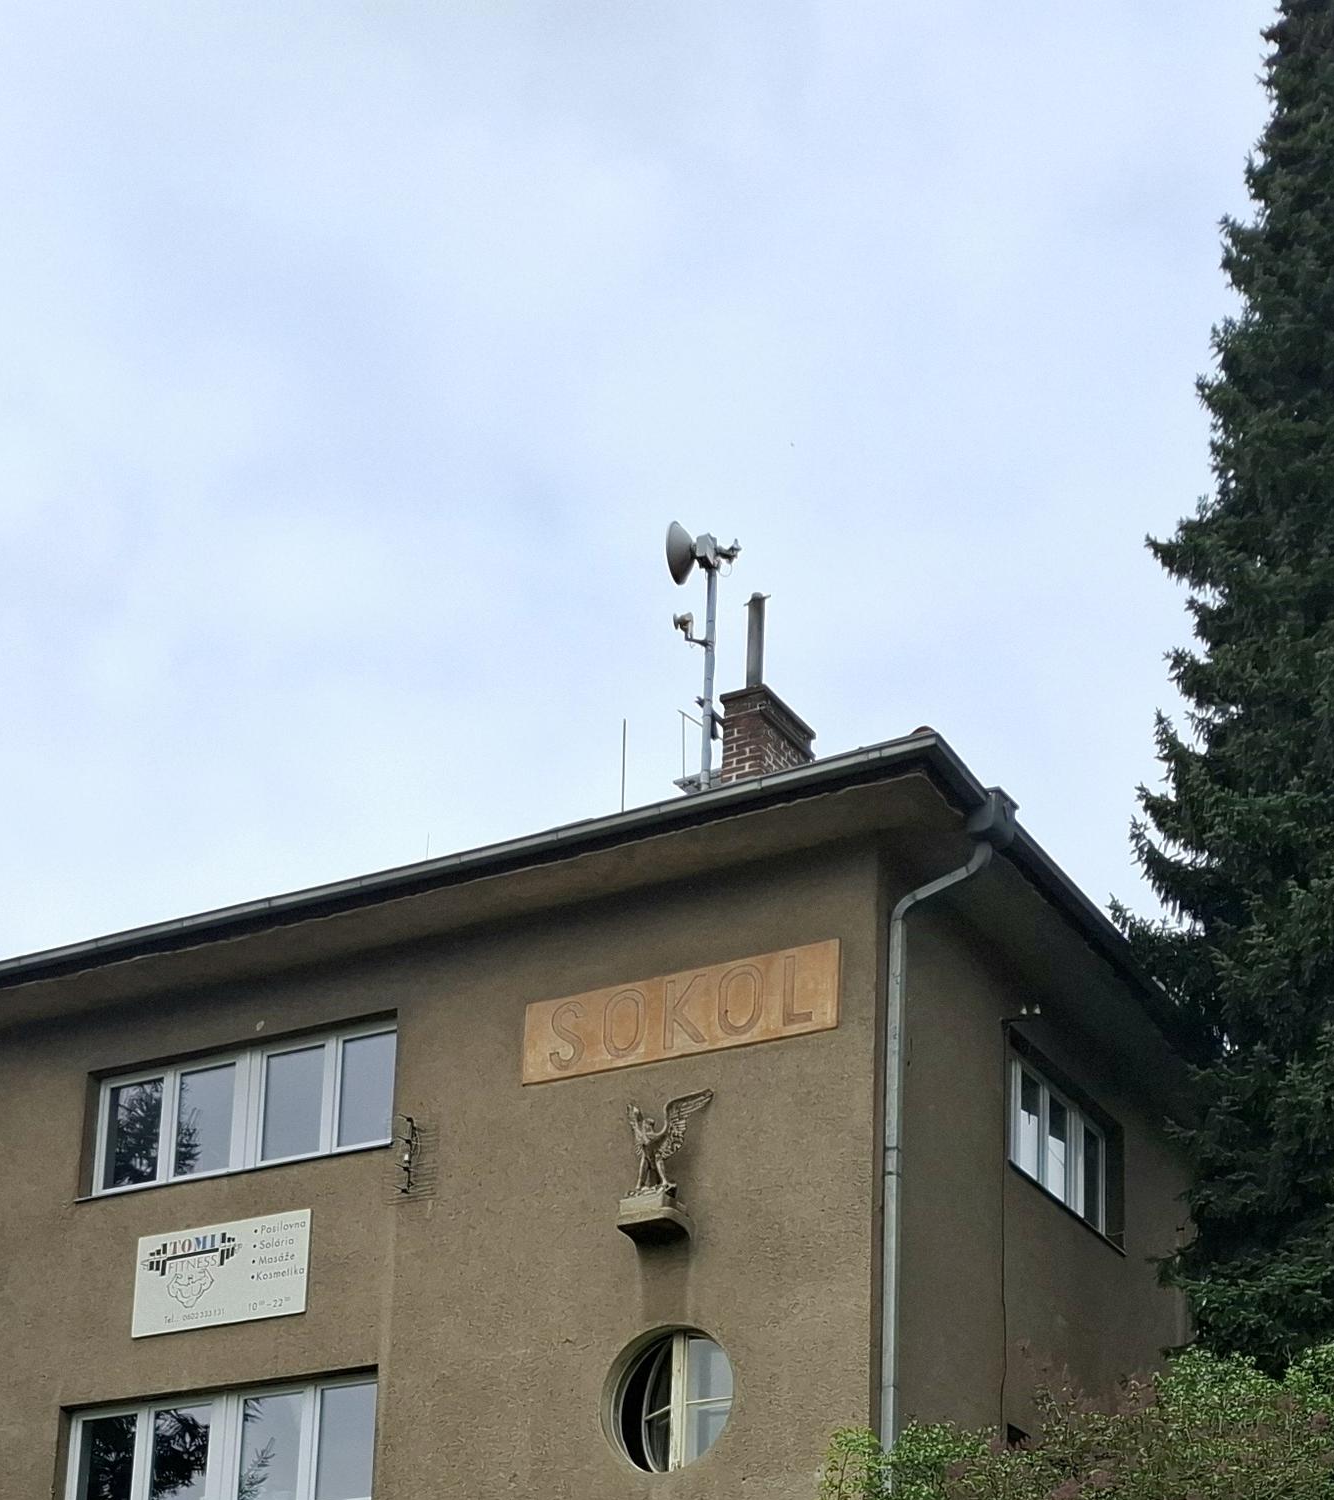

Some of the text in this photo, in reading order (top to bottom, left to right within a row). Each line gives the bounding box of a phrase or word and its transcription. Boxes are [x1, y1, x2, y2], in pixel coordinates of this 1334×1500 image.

[549, 955, 813, 1071] SOKOL
[260, 1220, 306, 1235] Posilovna
[169, 1234, 216, 1255] TOMI
[259, 1237, 295, 1250] Solária
[168, 1254, 218, 1274] FITNESS
[258, 1252, 295, 1265] Masáže
[256, 1266, 305, 1281] Kosmetika
